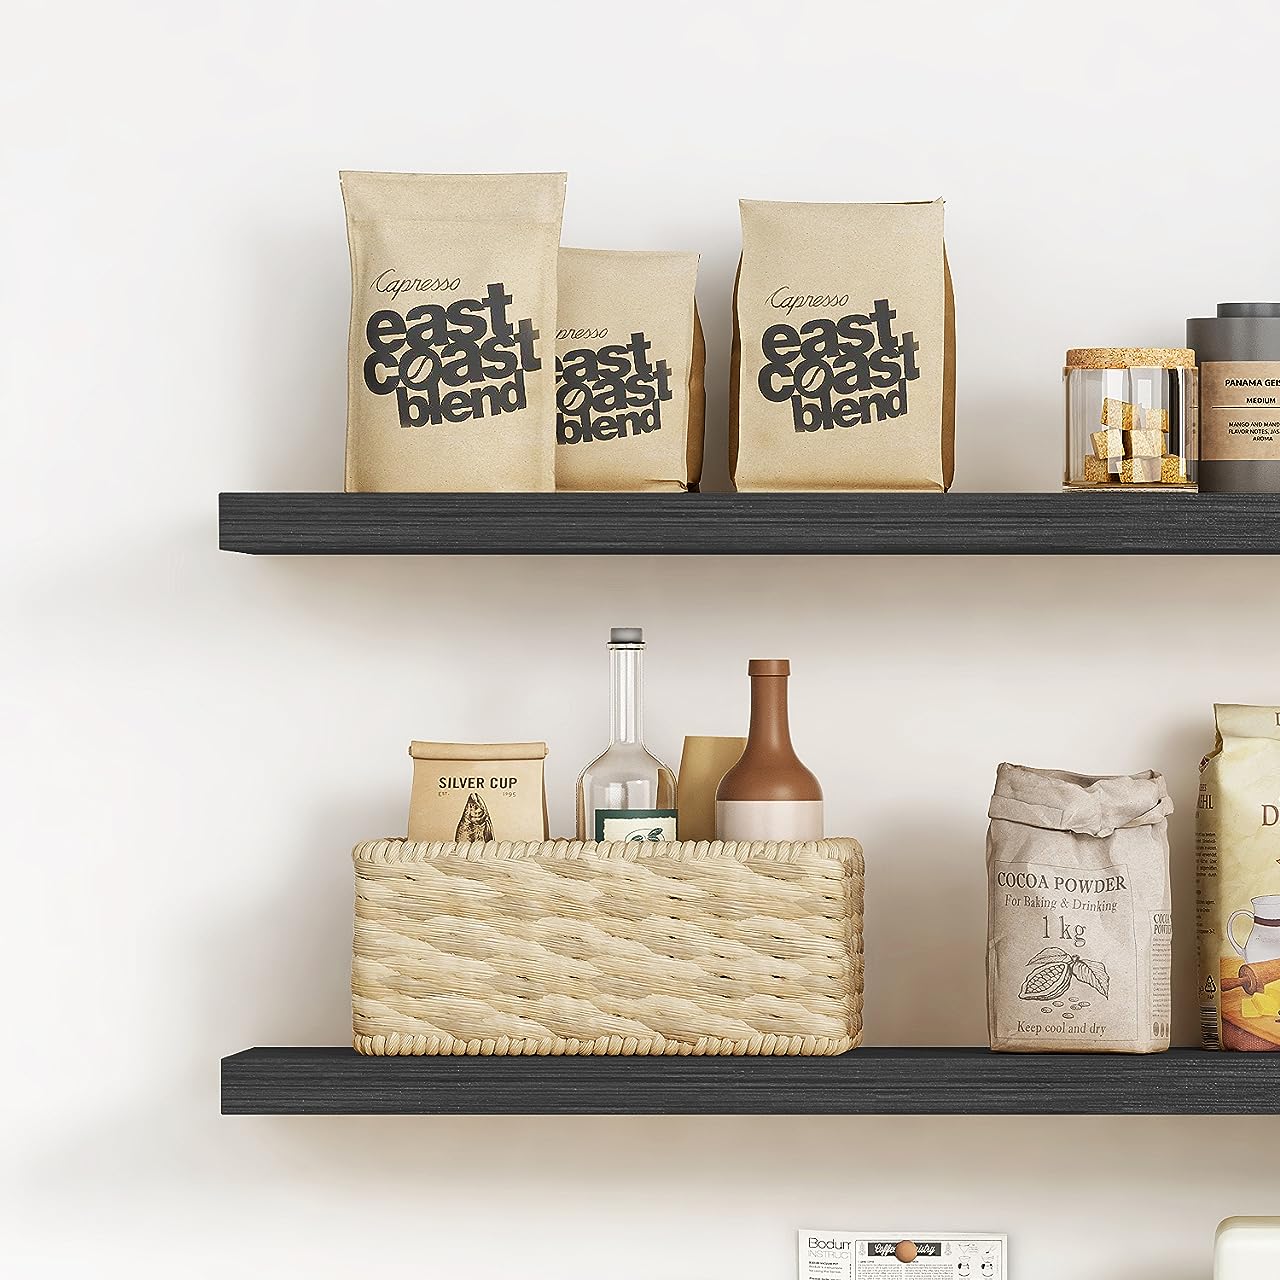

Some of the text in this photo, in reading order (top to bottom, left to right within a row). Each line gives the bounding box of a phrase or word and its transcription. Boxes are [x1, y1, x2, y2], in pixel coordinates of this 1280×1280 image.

[370, 268, 461, 301] Capresso
[764, 285, 849, 316] Capresso
[366, 282, 513, 353] east
[762, 299, 898, 364] east
[364, 318, 542, 395] coast
[555, 332, 652, 384] ast
[758, 331, 920, 402] coast
[396, 369, 527, 428] blend
[556, 359, 672, 416] oast
[791, 379, 907, 432] blend
[1225, 379, 1262, 387] PANAMA
[556, 399, 661, 445] blend
[438, 777, 518, 789] SILVER CUP
[997, 871, 1127, 894] COCOA POWDER
[1005, 894, 1118, 913] For Baking & Drinking
[1042, 915, 1087, 948] 1 kg
[1017, 1020, 1106, 1037] Keep cool and dry
